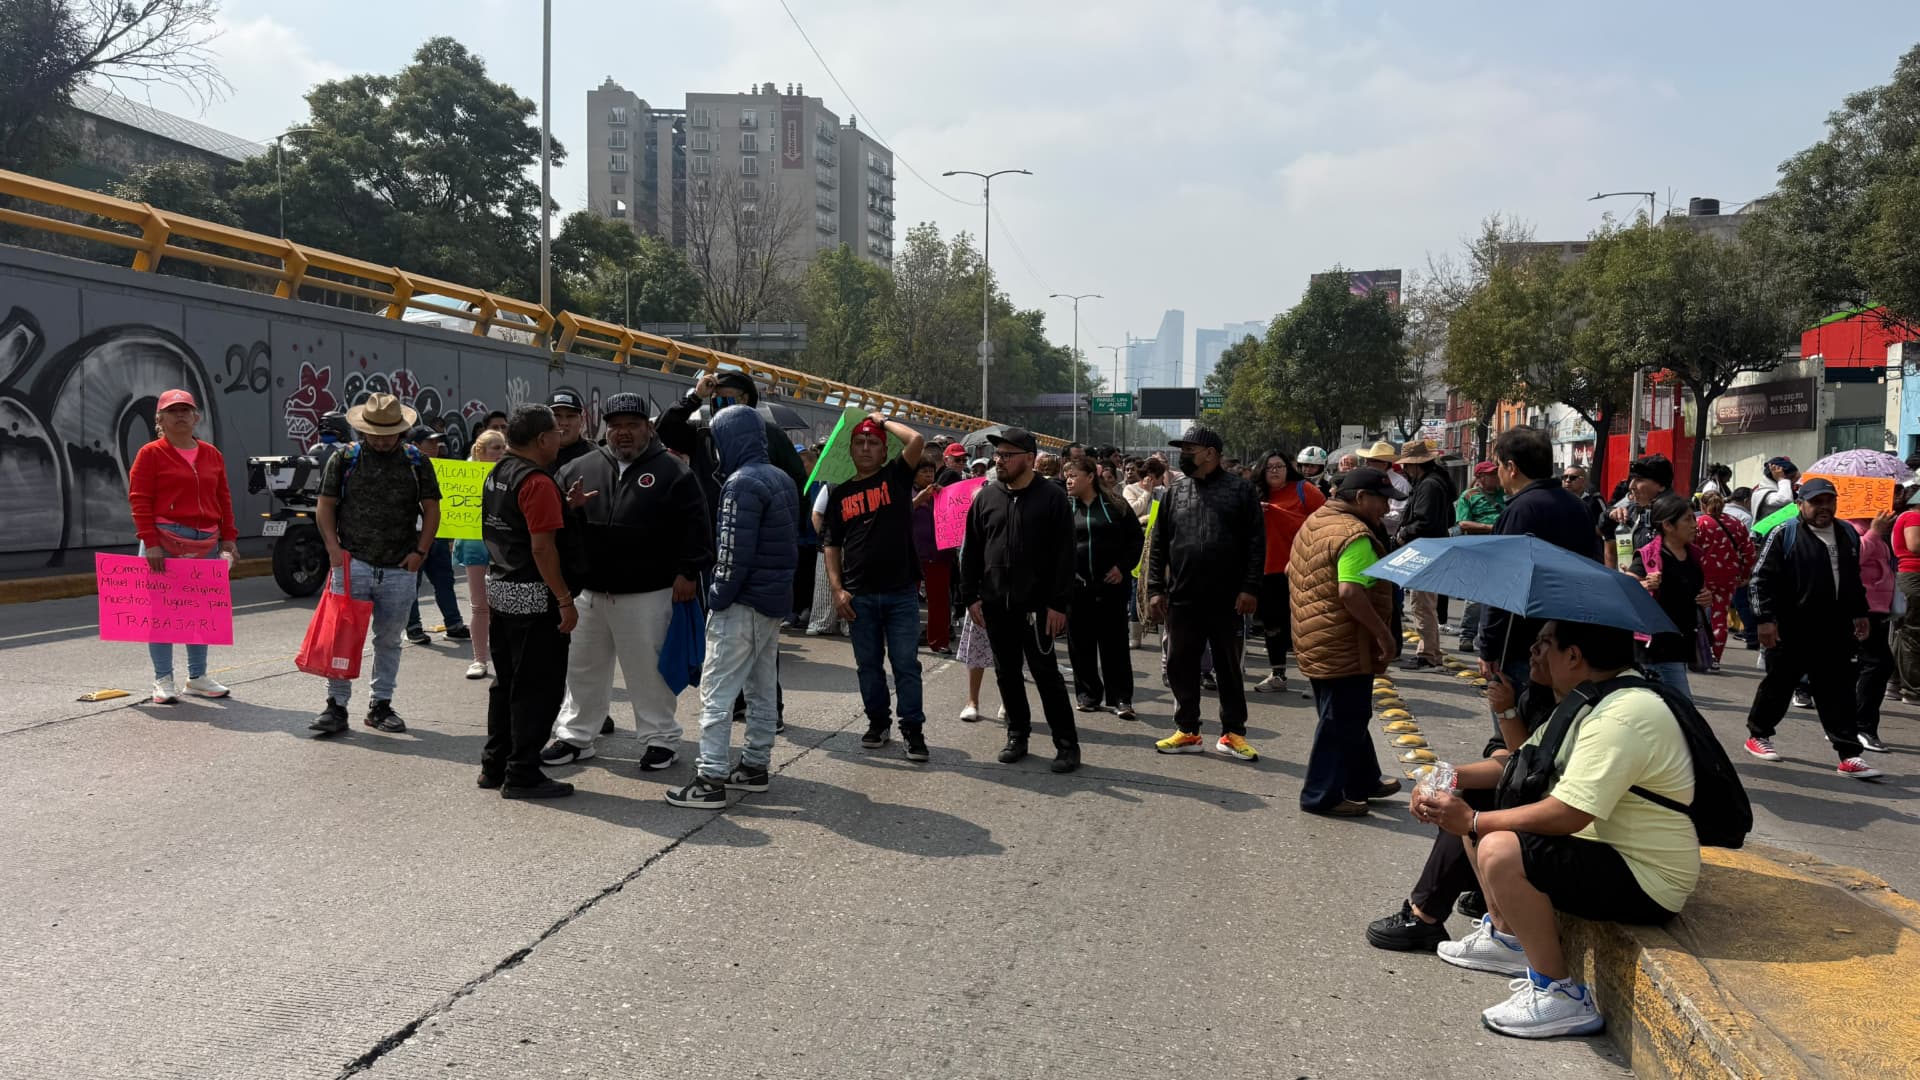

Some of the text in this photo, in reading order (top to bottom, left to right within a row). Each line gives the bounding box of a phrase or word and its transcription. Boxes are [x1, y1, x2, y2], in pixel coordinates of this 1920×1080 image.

[437, 464, 485, 480] ALCALDi
[440, 482, 477, 494] IDALGO
[448, 494, 482, 507] DEJ
[190, 564, 203, 579] de
[135, 579, 173, 595] Hidalgo
